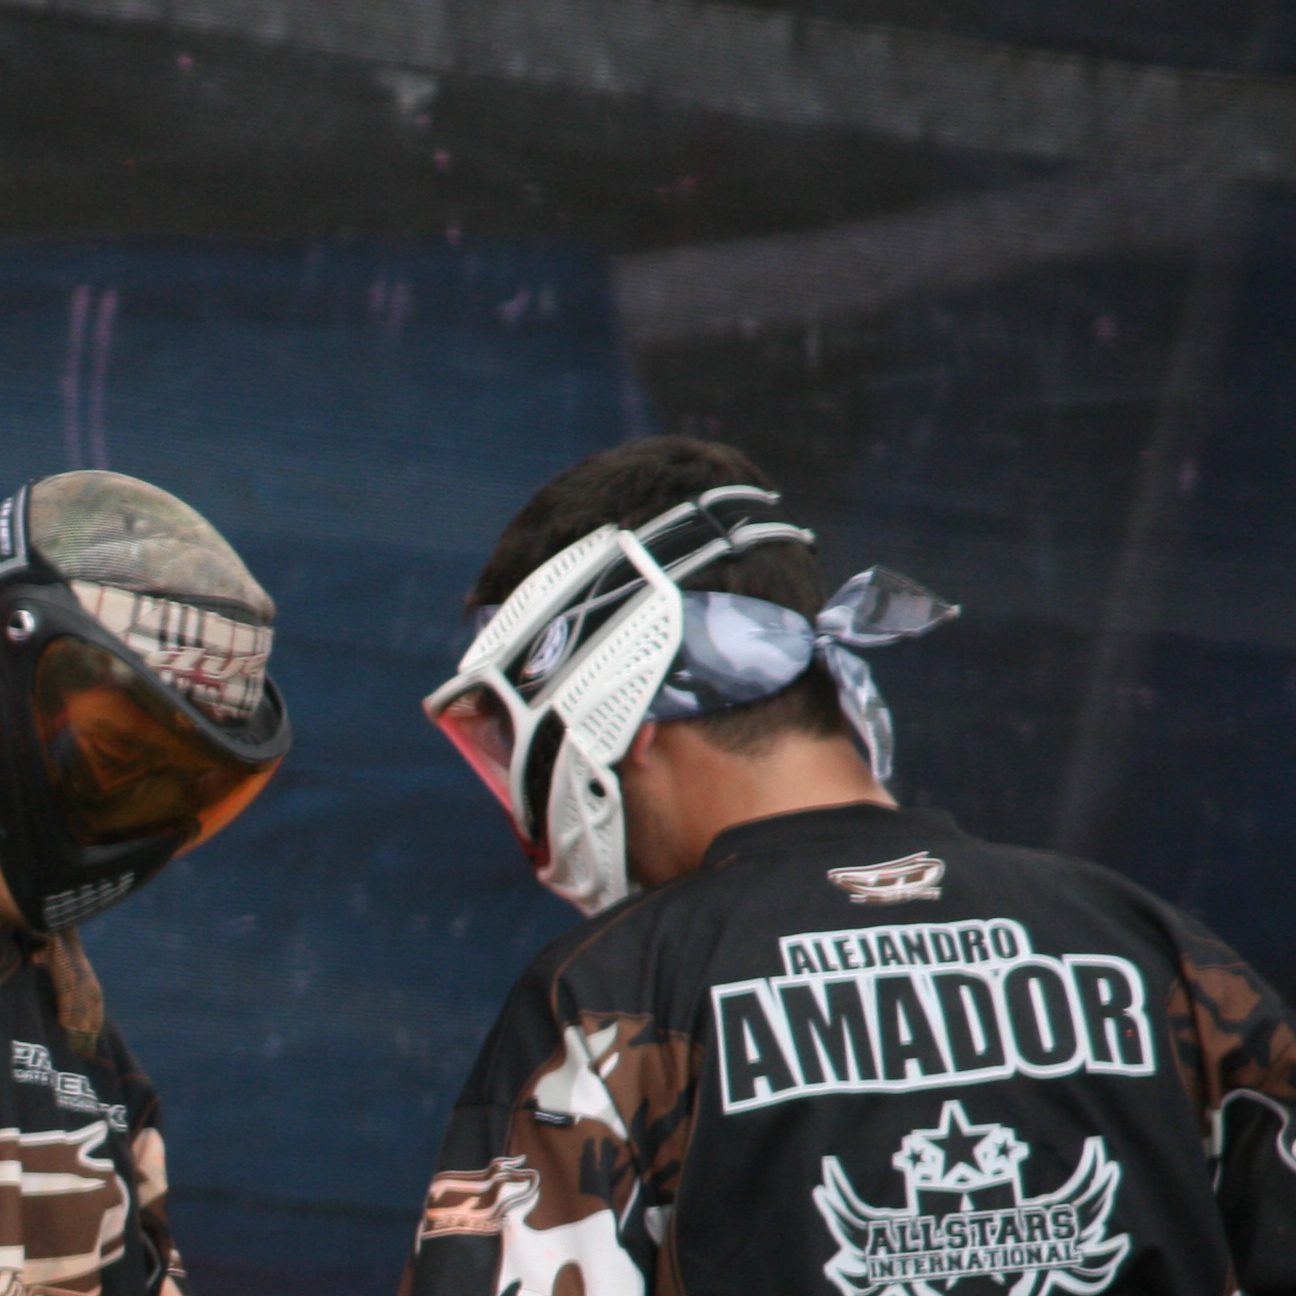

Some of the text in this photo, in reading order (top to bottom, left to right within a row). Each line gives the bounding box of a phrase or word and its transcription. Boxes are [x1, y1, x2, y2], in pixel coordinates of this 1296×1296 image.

[784, 921, 1022, 977] ALEJANDRO
[714, 957, 1154, 1112] AMADOR
[869, 1206, 1077, 1255] ALLSTARS
[869, 1241, 1081, 1280] INTERNATIONAL
